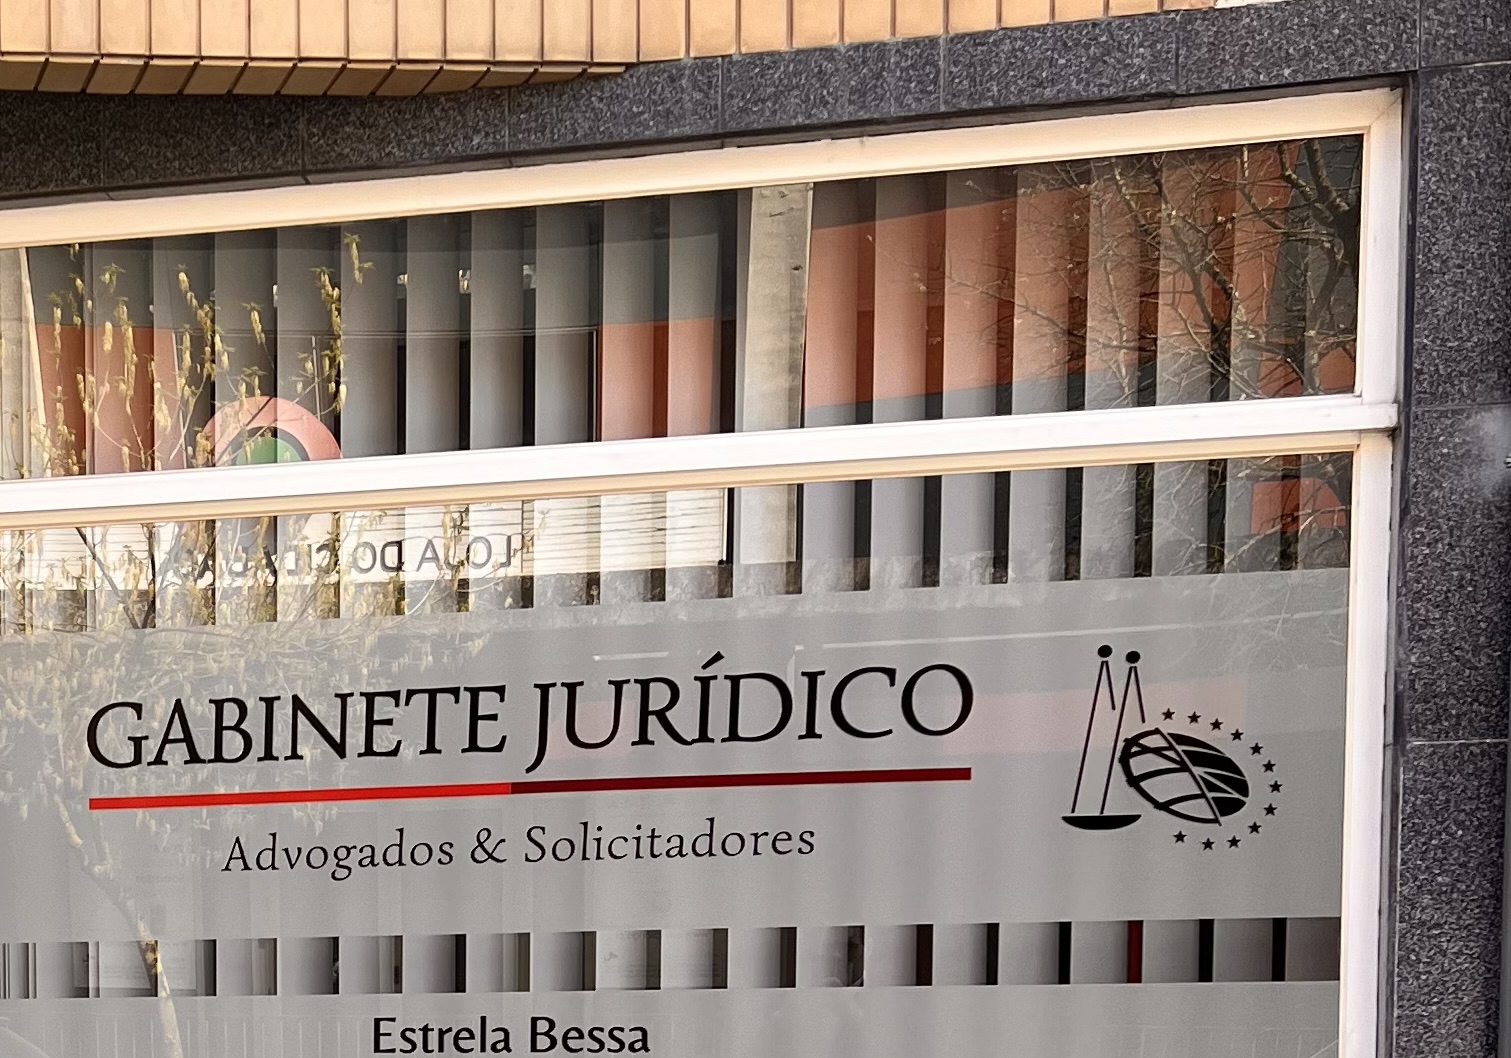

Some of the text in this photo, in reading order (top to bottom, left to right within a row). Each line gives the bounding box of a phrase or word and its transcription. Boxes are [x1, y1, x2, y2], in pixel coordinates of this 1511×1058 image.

[87, 650, 974, 773] GABINETE JURÍDICO
[221, 816, 818, 881] Advogados & Solicitadores
[371, 1015, 651, 1054] Estrela Bessa
